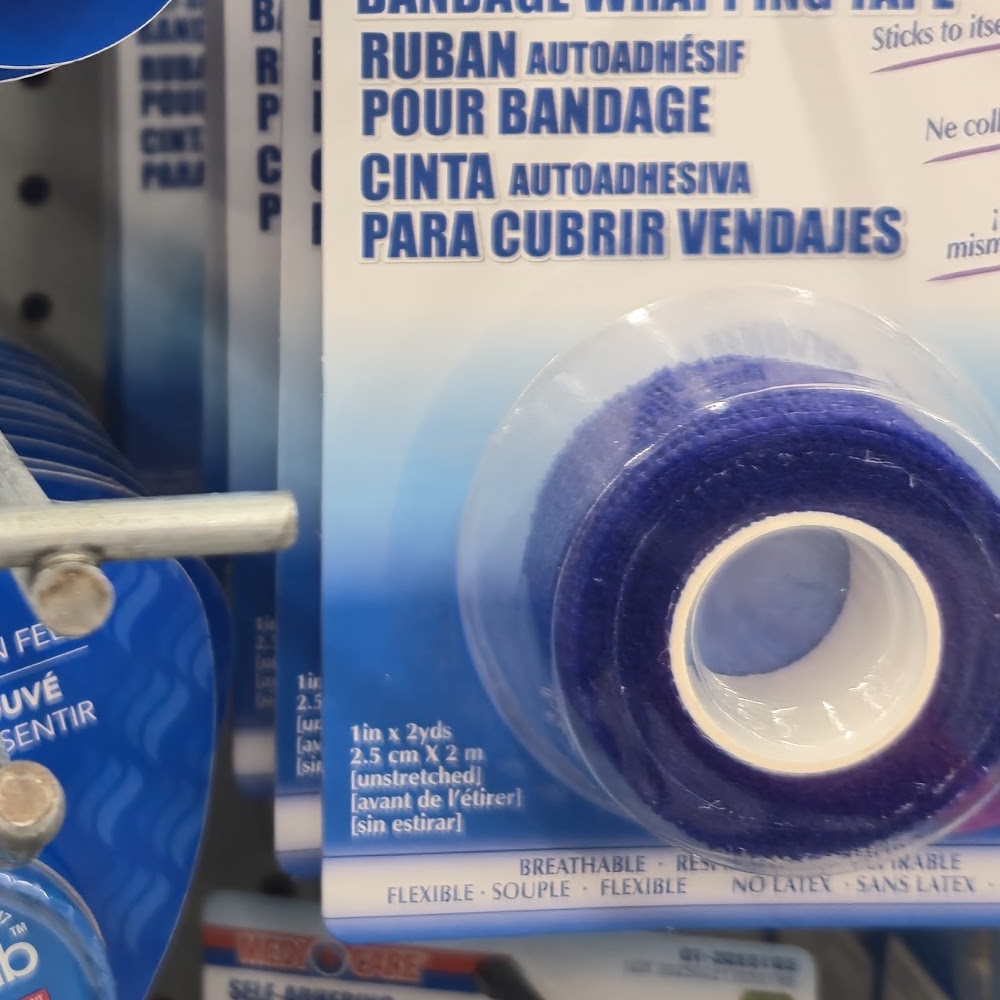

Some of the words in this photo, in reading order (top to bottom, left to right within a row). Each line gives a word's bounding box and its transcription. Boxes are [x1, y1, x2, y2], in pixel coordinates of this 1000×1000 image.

[872, 20, 934, 51] Sticks
[940, 20, 963, 42] to
[360, 31, 517, 80] RUBAN
[526, 34, 746, 76] AUTOADHÉSIF
[360, 88, 485, 137] POUR
[498, 87, 712, 135] BANDAGE
[925, 116, 958, 141] Ne
[360, 153, 496, 201] CINTA
[509, 161, 751, 197] AUTOADHESIVA
[360, 212, 479, 259] PARA
[491, 210, 666, 259] CUBRIR
[677, 207, 903, 257] VENDAJES
[0, 699, 98, 752] SENTIR
[350, 724, 382, 742] 1in
[388, 728, 400, 740] x
[405, 720, 453, 745] 2yds
[349, 747, 381, 765] 2.5
[388, 750, 419, 764] cm
[445, 747, 459, 761] 2
[464, 747, 485, 761] m
[350, 766, 482, 790] [unstretched]
[350, 790, 412, 815] [avant
[417, 790, 441, 808] de
[351, 813, 387, 837] [sin
[392, 811, 463, 834] estirar]
[519, 854, 647, 877] BREATHABLE
[387, 884, 474, 904] FLEXIBLE
[492, 880, 570, 900] SOUPLE
[601, 878, 687, 896] FLEXIBLE
[732, 875, 764, 893] NO
[773, 876, 831, 893] LATEX
[857, 875, 910, 893] SANS
[917, 875, 976, 893] LATEX
